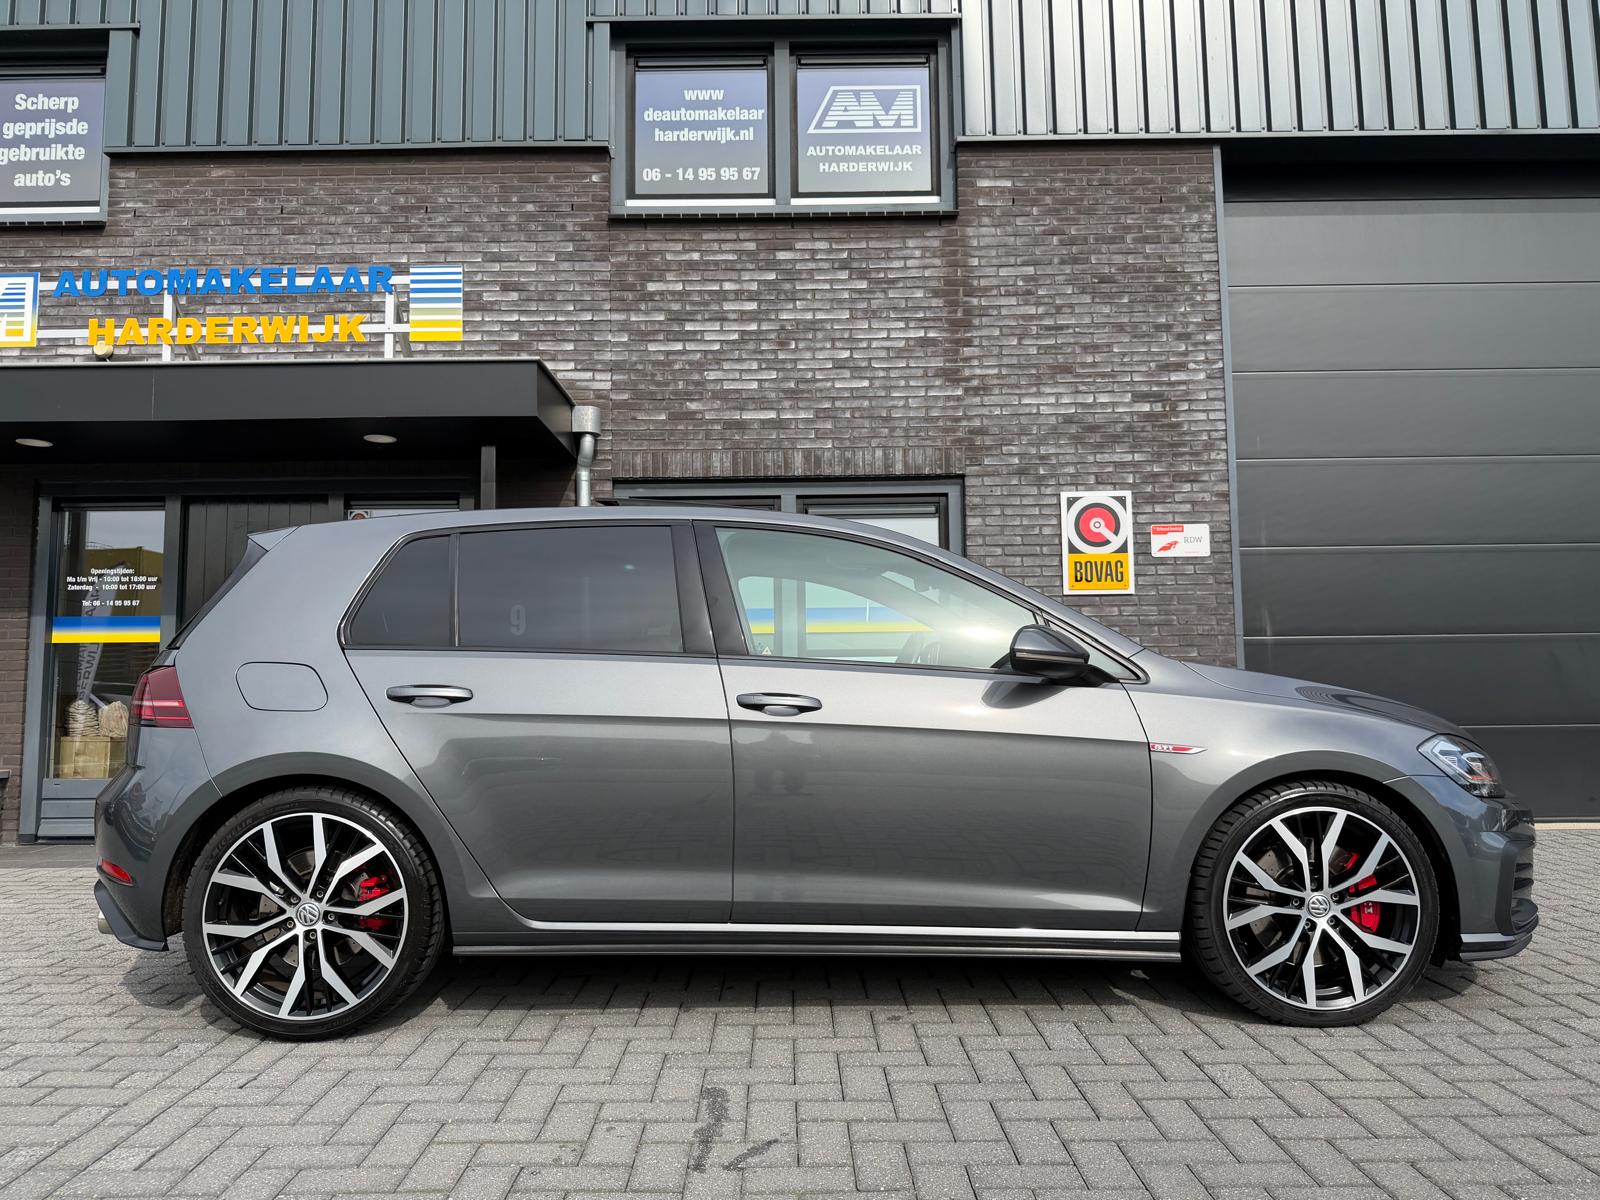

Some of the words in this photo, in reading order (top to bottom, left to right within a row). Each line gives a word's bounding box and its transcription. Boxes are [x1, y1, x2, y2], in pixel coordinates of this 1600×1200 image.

[14, 93, 79, 113] Scherp
[684, 89, 724, 101] www
[643, 107, 765, 121] deautomakelaar
[2, 118, 89, 139] geprijsde
[654, 127, 754, 143] harderwijk.nl
[0, 143, 85, 165] gebruikte
[807, 145, 921, 156] AUTOMAKELAAR
[642, 168, 661, 181] 06
[676, 168, 694, 181] 14
[698, 167, 716, 180] 95
[720, 167, 739, 180] 95
[742, 167, 760, 180] 67
[819, 161, 913, 173] HARDERWIJK
[13, 170, 71, 187] auto's
[53, 265, 394, 298] AUTOMAKELAAR
[87, 314, 367, 345] HARDERWIJK
[1074, 559, 1124, 583] BOVAG
